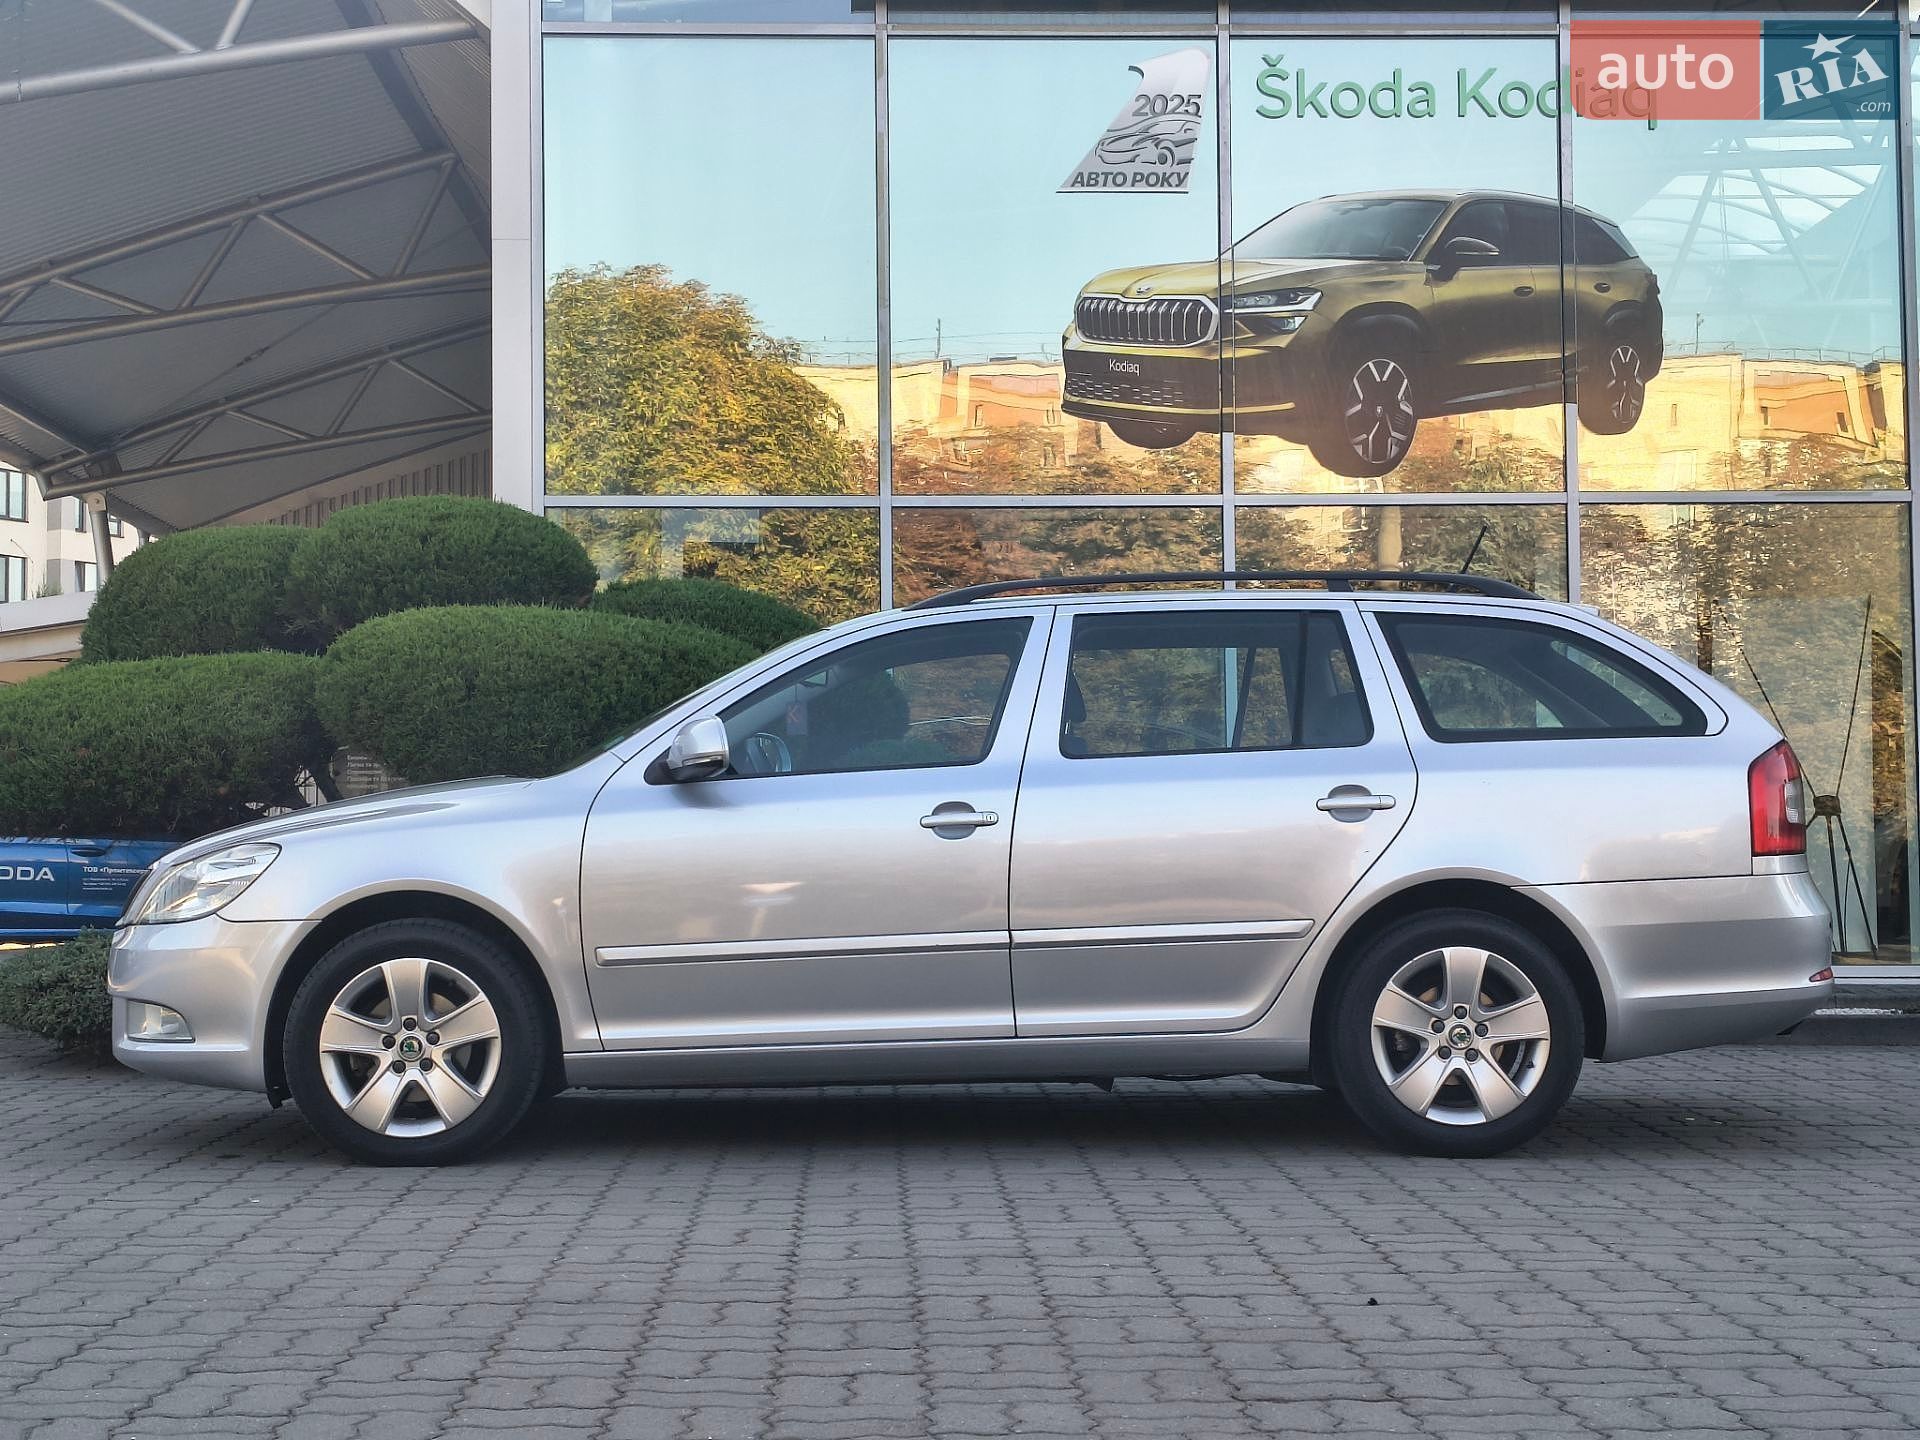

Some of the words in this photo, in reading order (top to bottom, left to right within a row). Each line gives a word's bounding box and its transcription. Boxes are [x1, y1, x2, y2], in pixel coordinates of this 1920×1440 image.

[1256, 54, 1436, 119] Škoda
[1132, 93, 1202, 117] 2025
[1071, 171, 1128, 188] АВТО
[1131, 171, 1189, 188] РОКУ
[1109, 358, 1140, 376] Kodiaq
